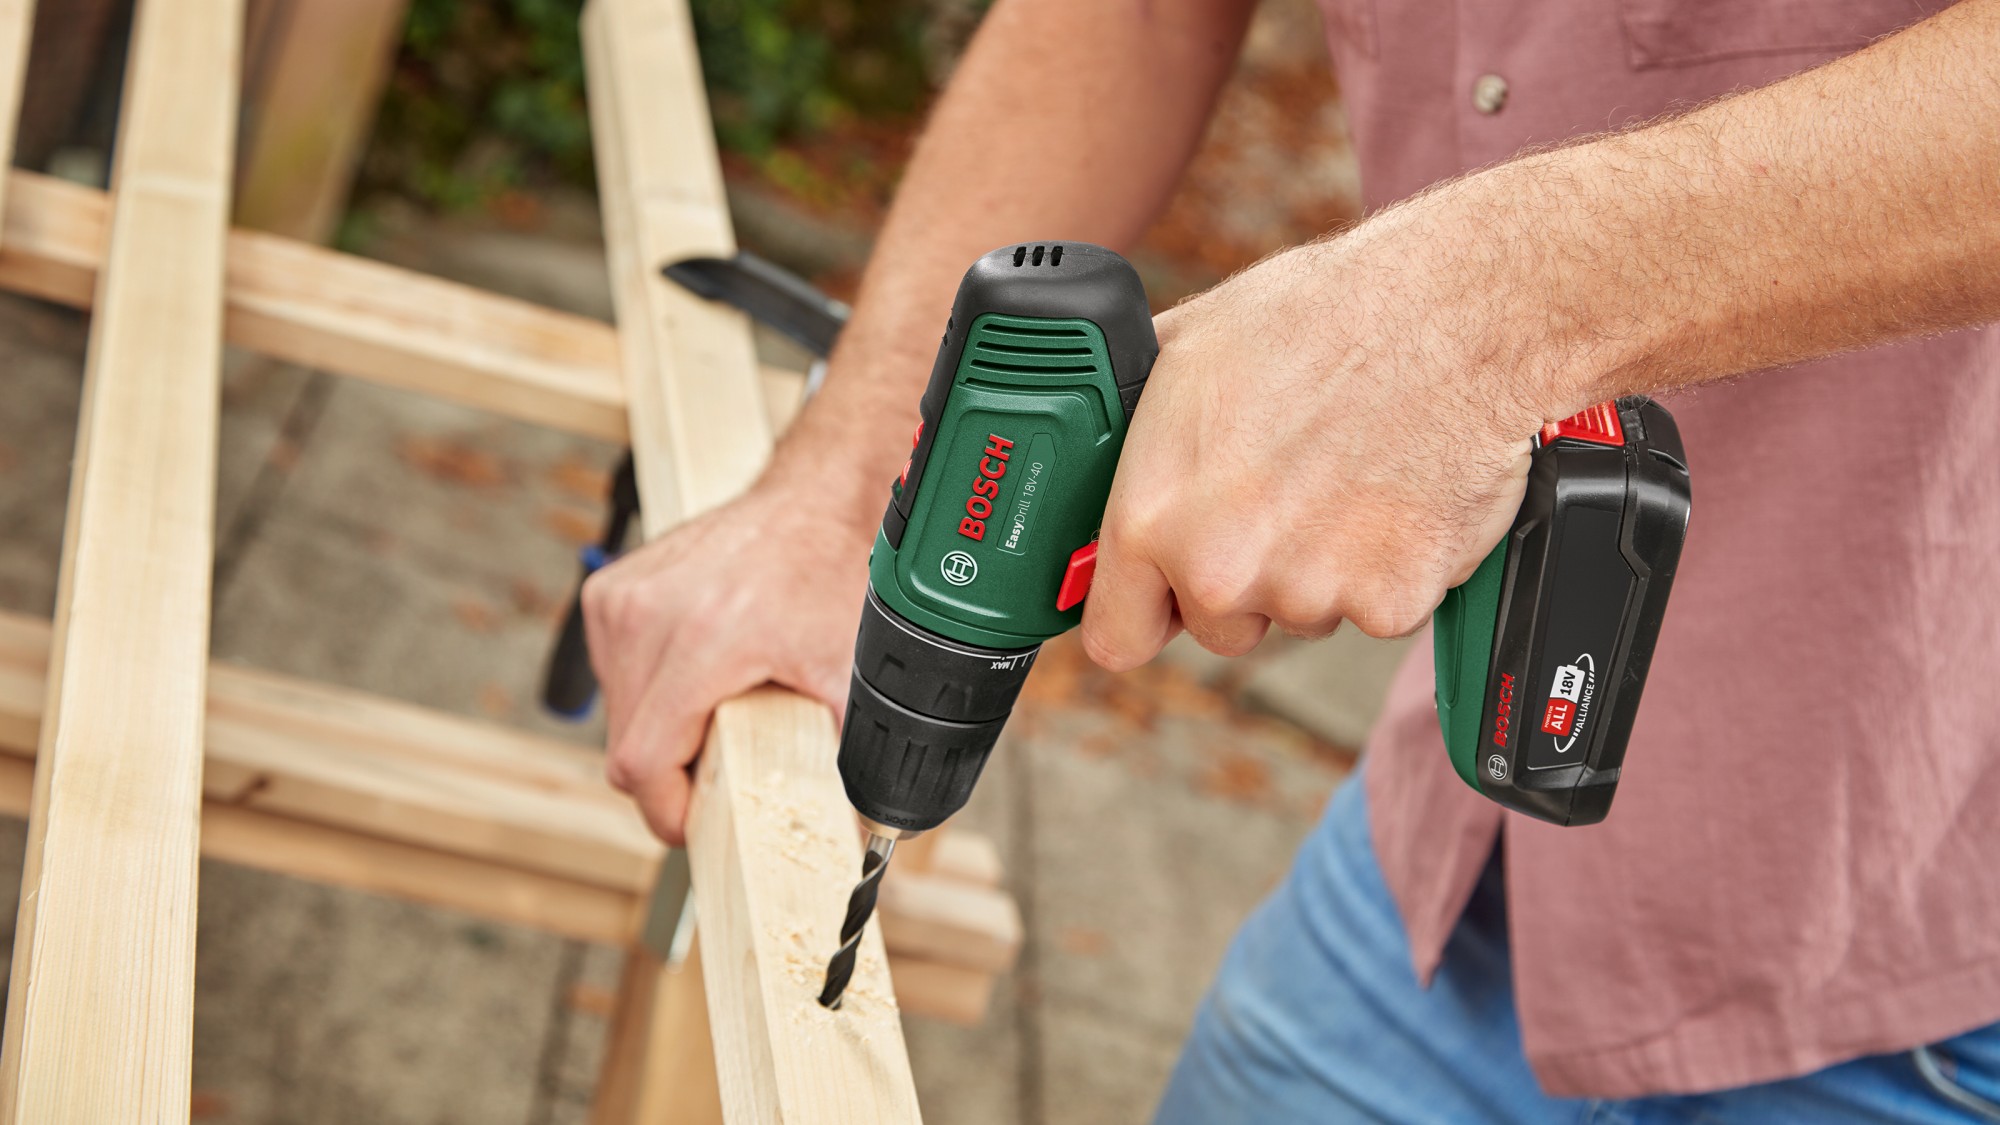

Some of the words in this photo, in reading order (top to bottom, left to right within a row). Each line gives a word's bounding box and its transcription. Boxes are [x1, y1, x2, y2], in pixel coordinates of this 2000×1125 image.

[957, 433, 1014, 542] BOSCH
[1004, 499, 1031, 549] EasyDrill
[1023, 462, 1043, 497] 18V-40
[990, 661, 1011, 670] MAX
[1493, 672, 1515, 748] BOSCH
[1551, 704, 1568, 730] ALL
[1560, 670, 1576, 696] 18V
[1576, 683, 1595, 729] ALLIANCE
